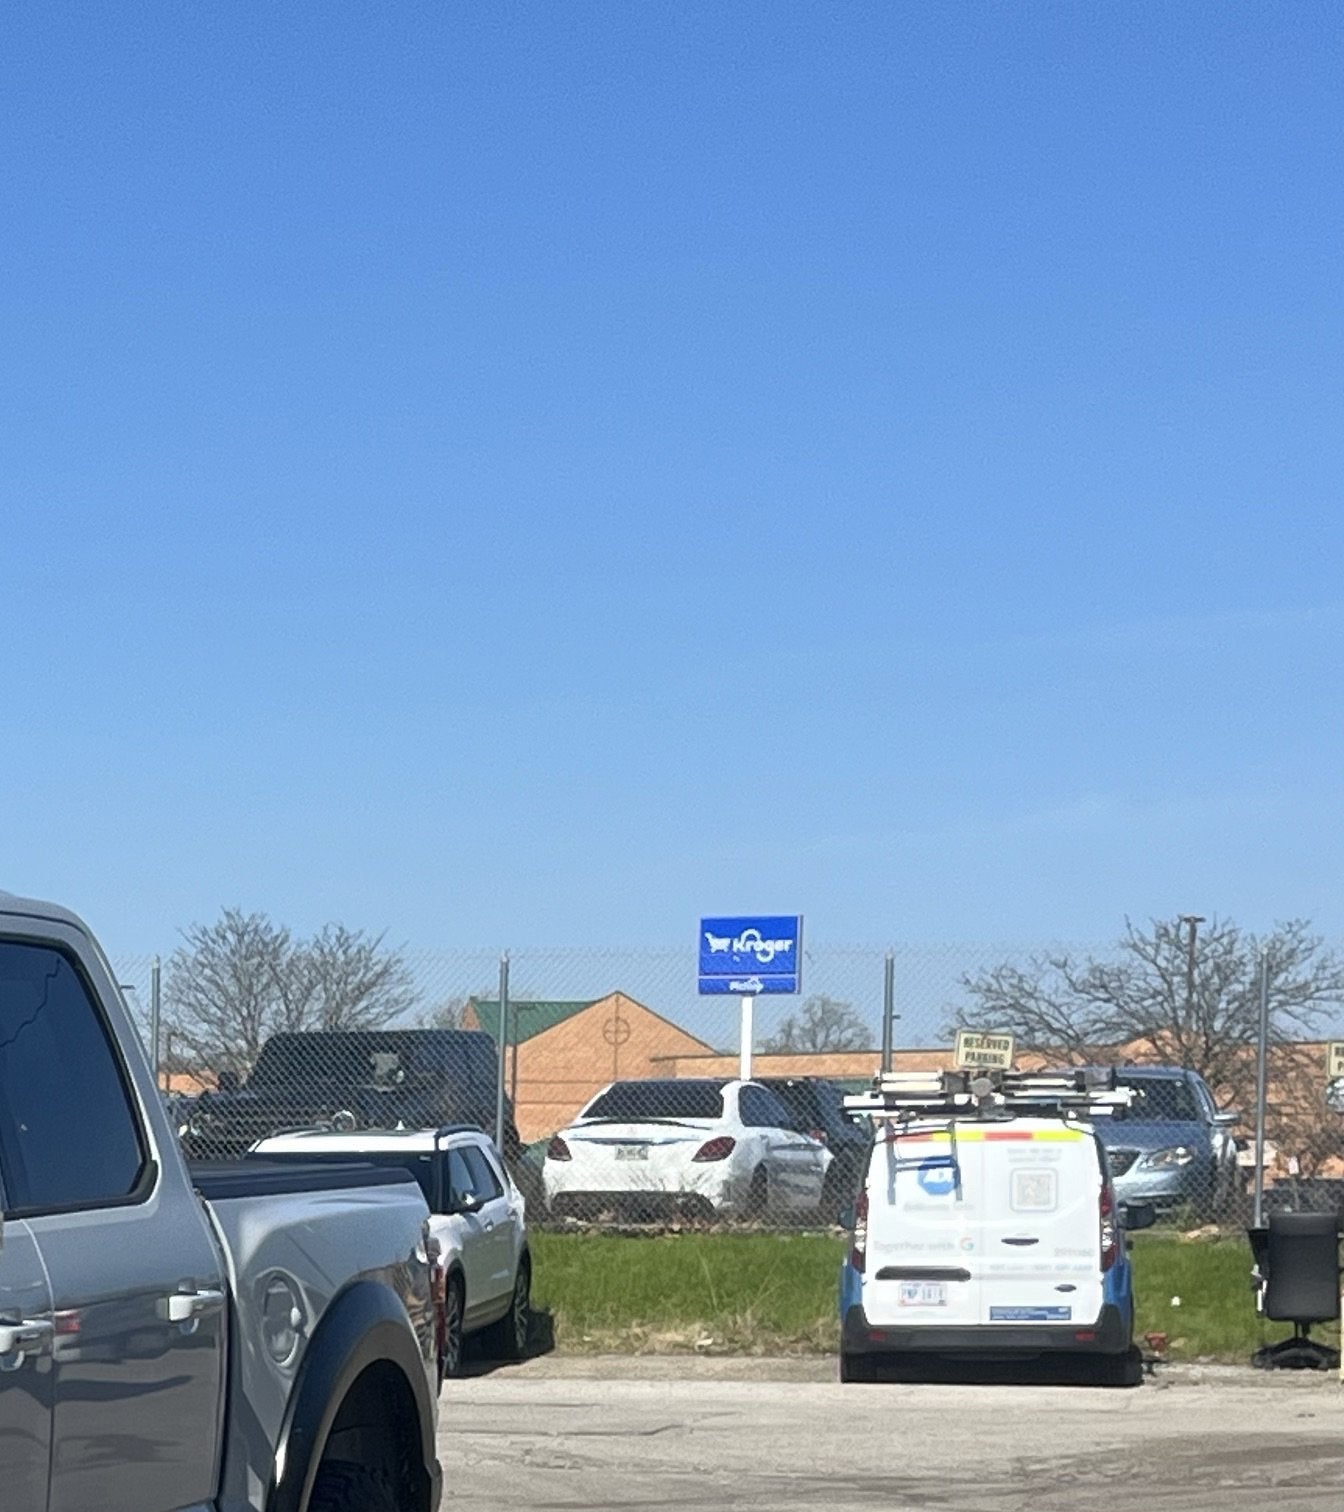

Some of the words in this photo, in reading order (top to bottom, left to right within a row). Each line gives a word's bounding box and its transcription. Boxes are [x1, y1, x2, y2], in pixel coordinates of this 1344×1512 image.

[732, 928, 793, 963] Kroger
[963, 1036, 1010, 1051] RESERVED
[964, 1051, 1005, 1065] PARKING
[873, 1240, 924, 1254] Together
[928, 1240, 954, 1249] with
